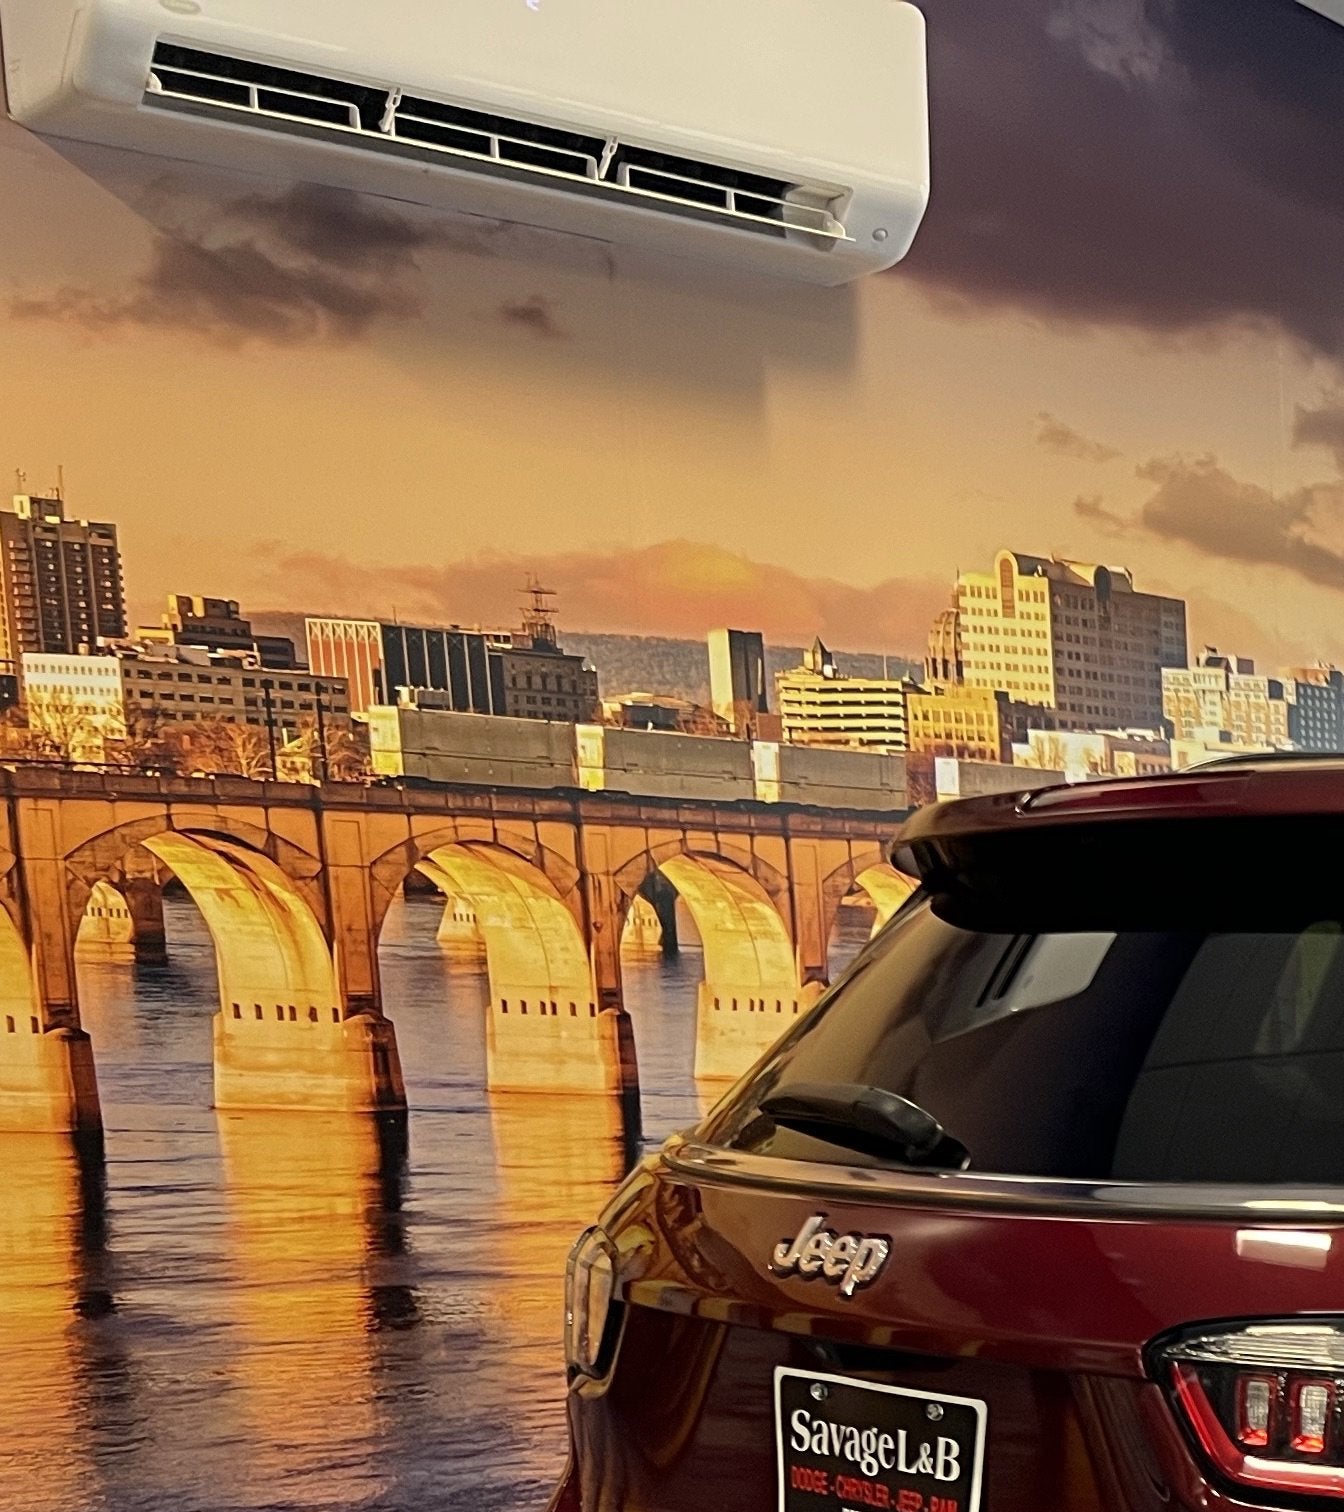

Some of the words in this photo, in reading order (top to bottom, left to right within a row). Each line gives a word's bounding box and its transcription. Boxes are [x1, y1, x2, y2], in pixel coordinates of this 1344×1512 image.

[773, 1215, 890, 1296] Jeep
[791, 1465, 829, 1496] DODGE
[835, 1474, 891, 1509] CHRYSLER
